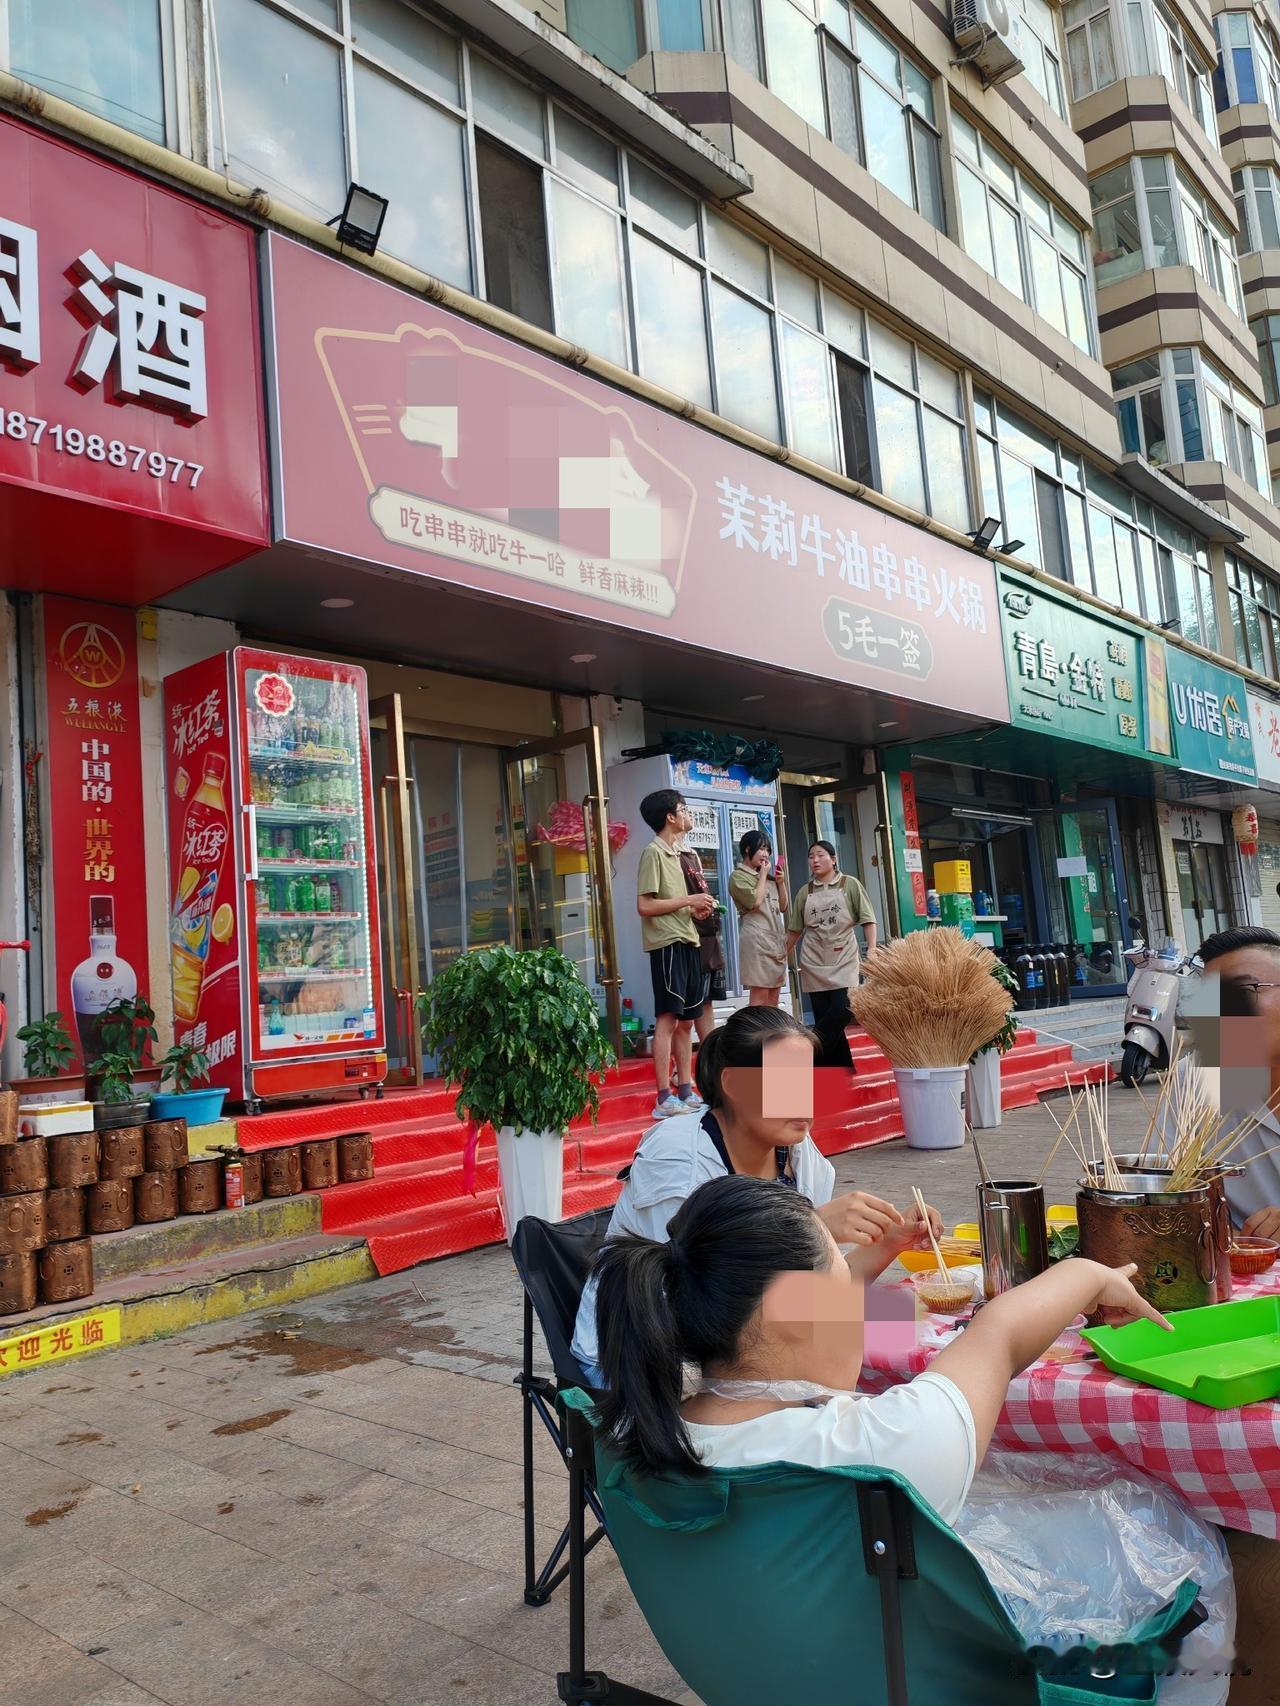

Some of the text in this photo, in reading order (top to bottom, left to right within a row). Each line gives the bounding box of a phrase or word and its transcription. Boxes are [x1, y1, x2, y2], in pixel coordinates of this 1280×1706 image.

[0, 407, 204, 489] 18719887977
[400, 505, 565, 577] 吃串串就吃牛一哈
[715, 475, 987, 634] 茉莉牛油串串火锅
[837, 609, 921, 671] 5毛一签
[64, 716, 127, 733] WULIANGYE
